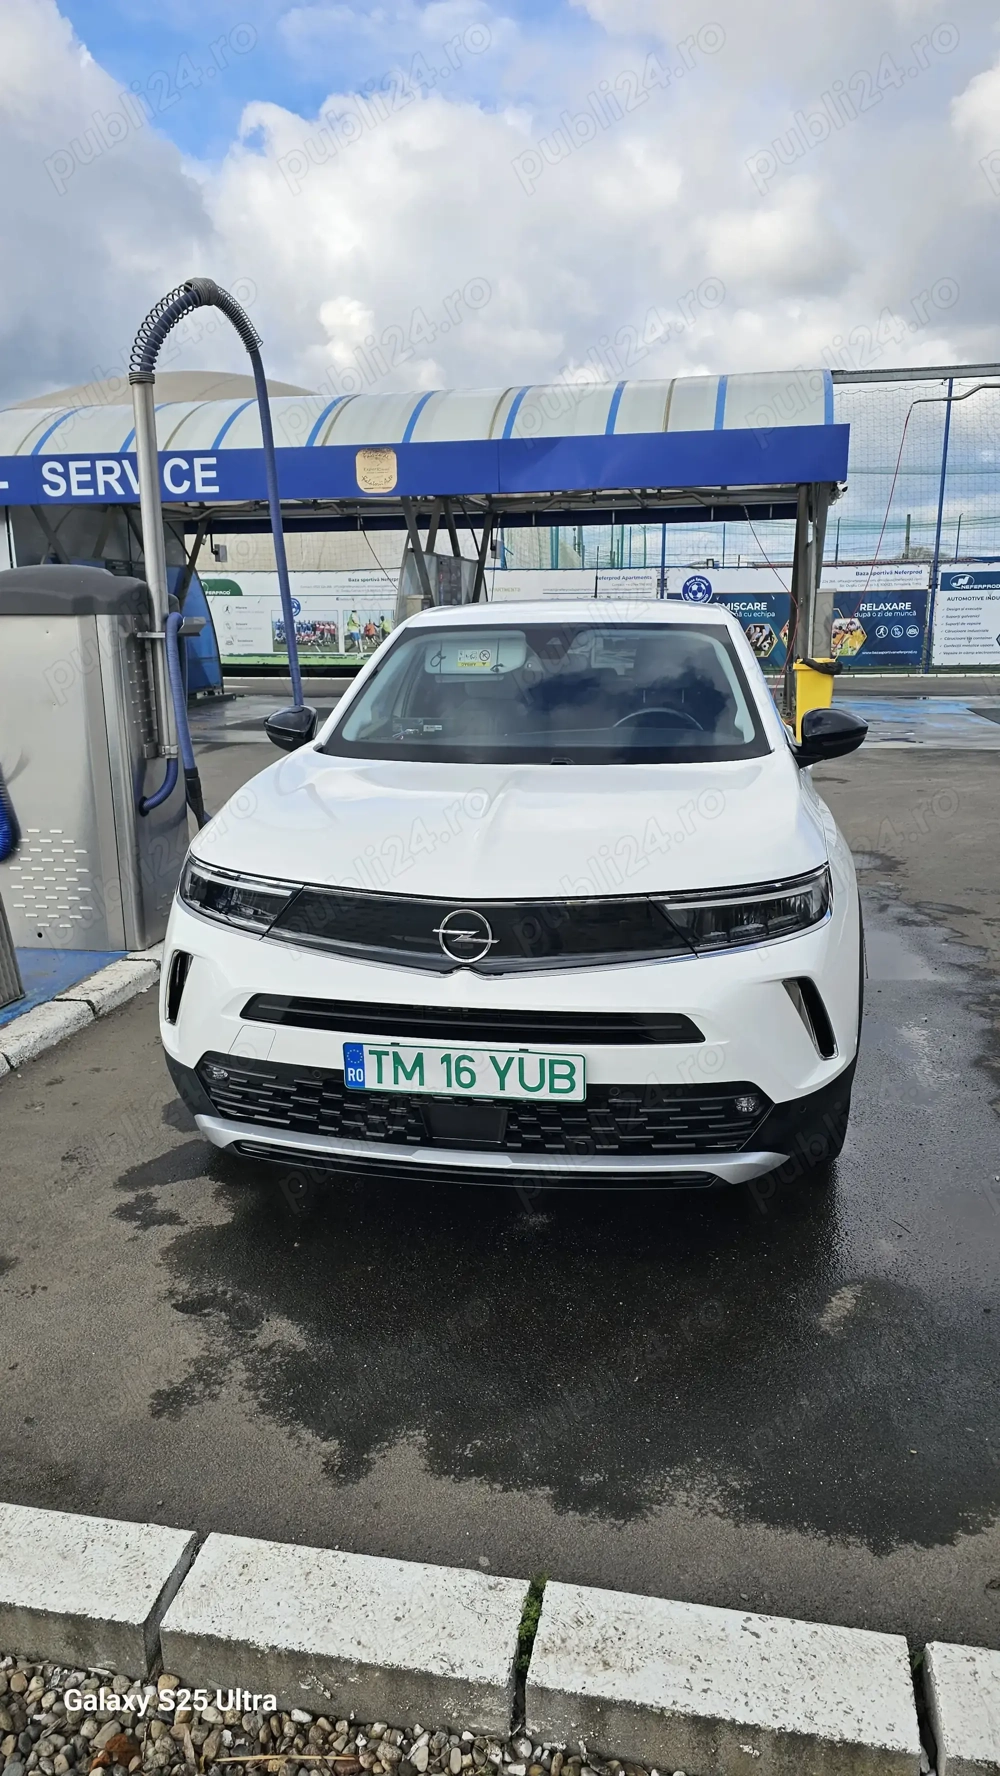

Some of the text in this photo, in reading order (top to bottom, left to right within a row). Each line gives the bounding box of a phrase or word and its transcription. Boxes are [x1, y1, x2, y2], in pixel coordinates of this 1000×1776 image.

[42, 457, 220, 497] SERVCE
[859, 602, 912, 611] RELAXARE
[348, 1050, 577, 1094] RO TM 16 YUB
